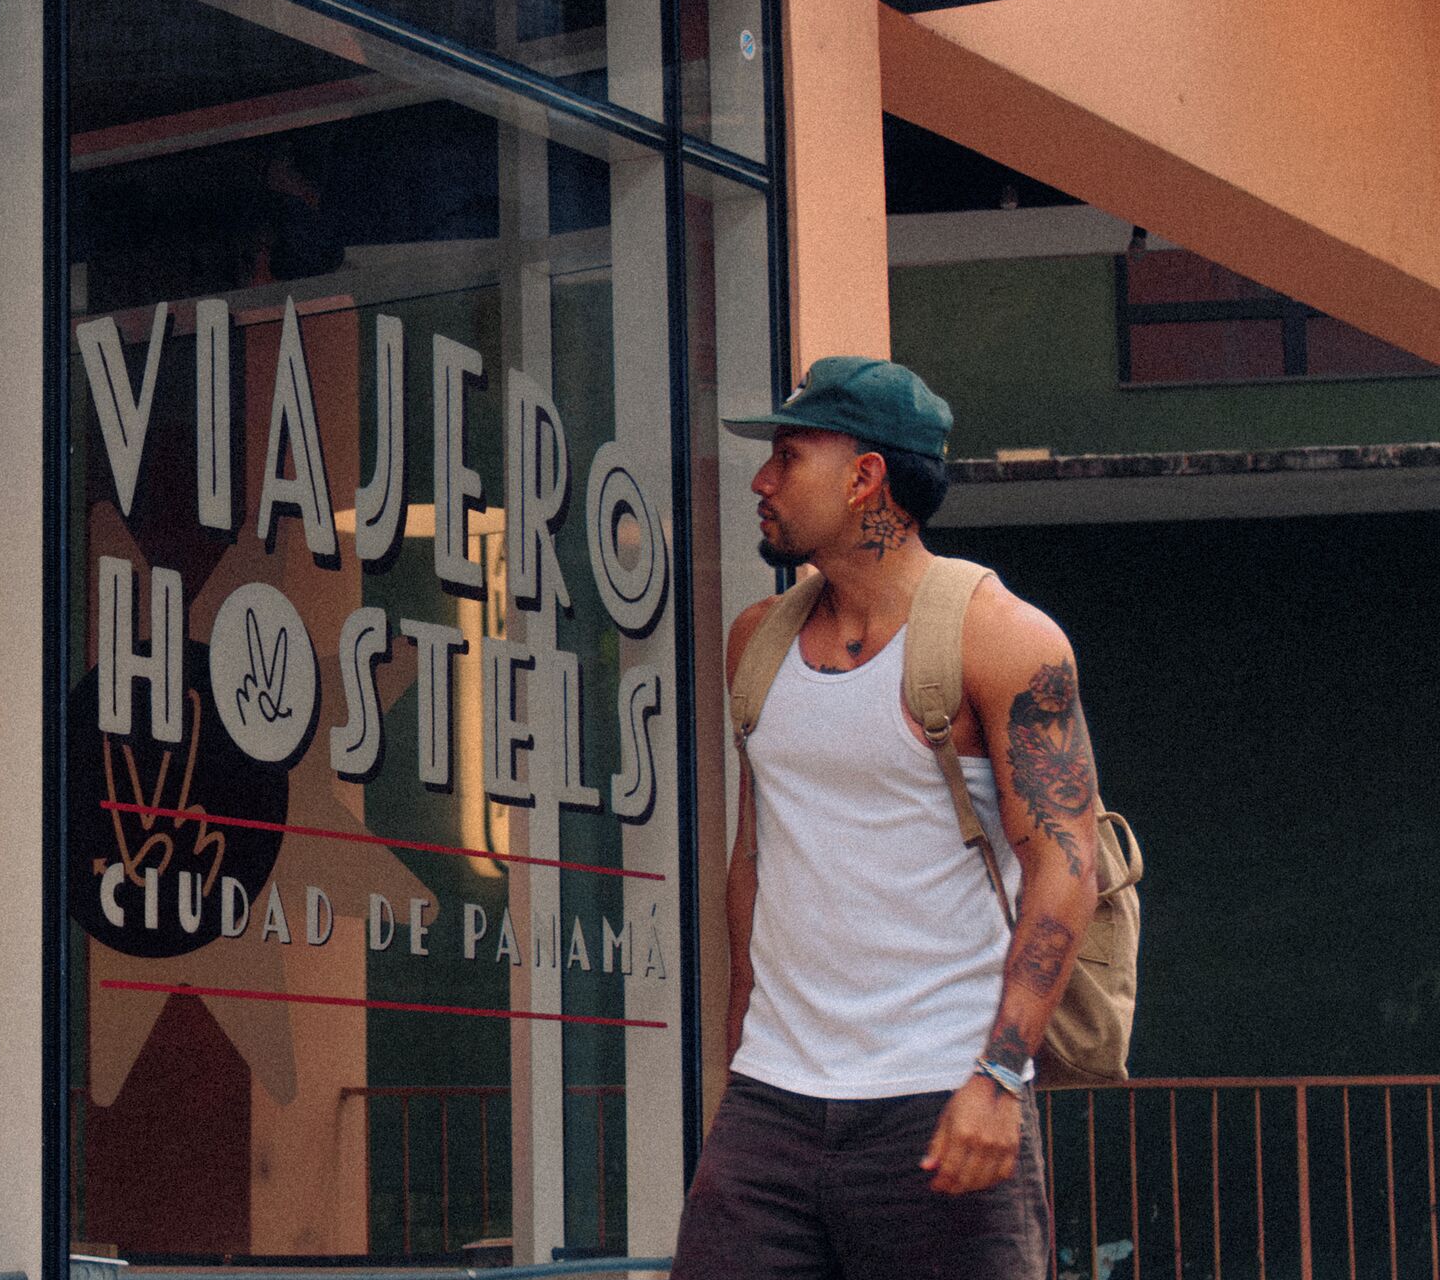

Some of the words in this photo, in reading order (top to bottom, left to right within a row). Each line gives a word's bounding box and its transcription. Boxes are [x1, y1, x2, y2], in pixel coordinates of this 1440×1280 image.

[76, 295, 671, 638] VIAJERO
[97, 556, 665, 826] HOSTELS
[100, 862, 335, 946] CIUDAD
[369, 893, 431, 956] DE
[464, 902, 667, 979] PANAMÁ
